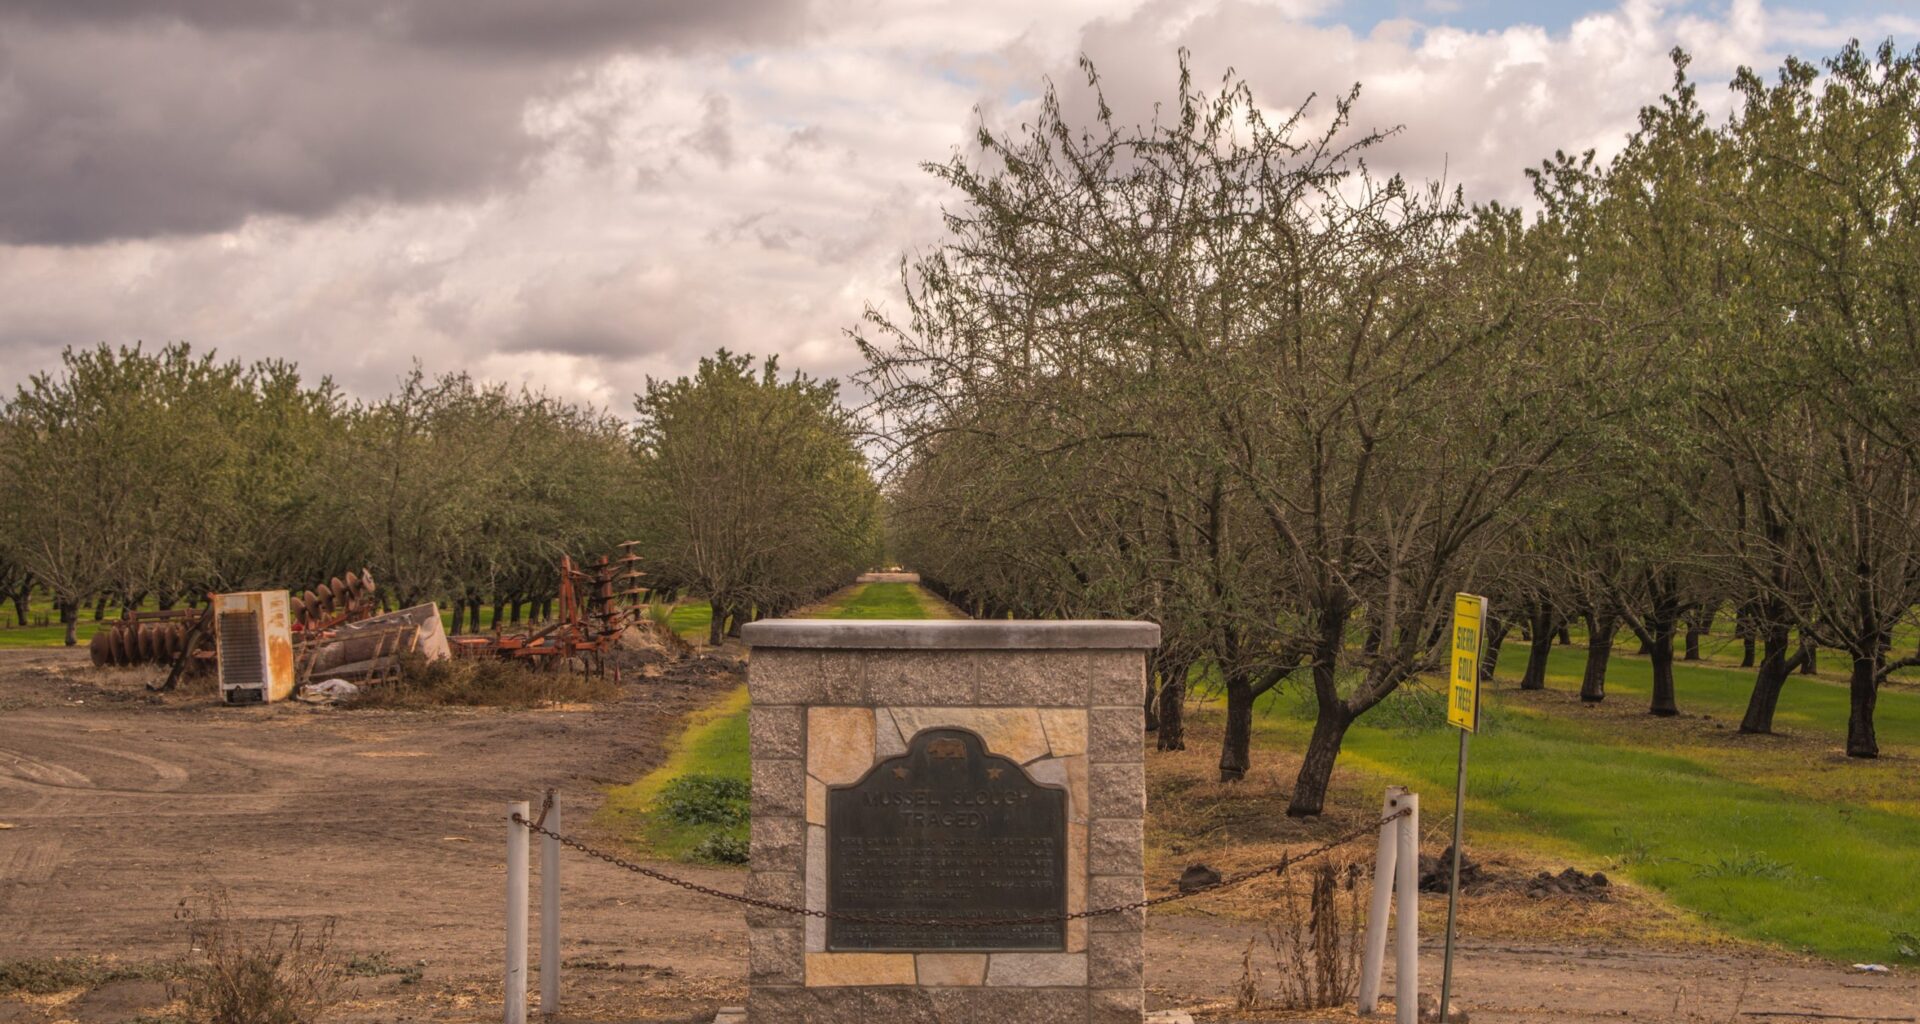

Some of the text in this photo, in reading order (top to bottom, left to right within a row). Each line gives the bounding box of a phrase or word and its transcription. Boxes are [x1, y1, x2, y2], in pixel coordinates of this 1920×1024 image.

[1456, 626, 1477, 653] SIERRA
[1457, 656, 1473, 682] GOLD
[1454, 685, 1473, 713] TREES
[863, 790, 1031, 808] MUSSEL SLOUGH
